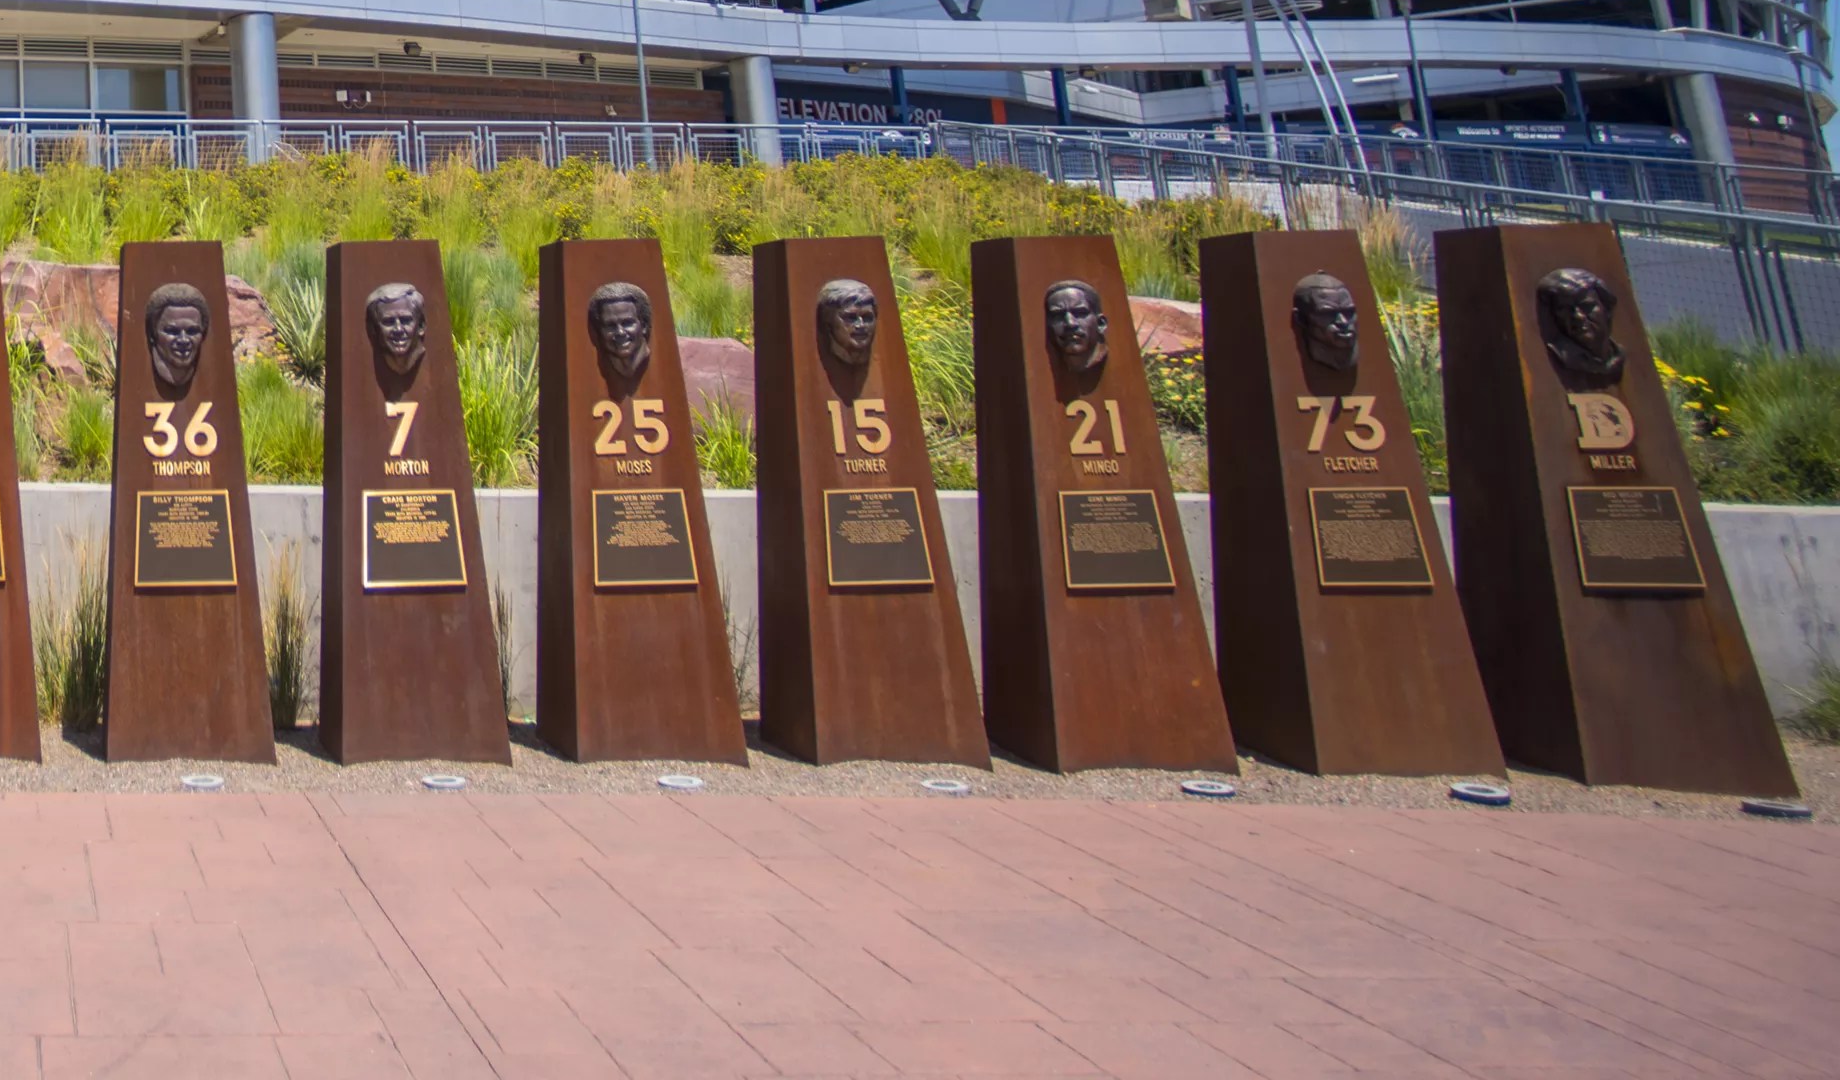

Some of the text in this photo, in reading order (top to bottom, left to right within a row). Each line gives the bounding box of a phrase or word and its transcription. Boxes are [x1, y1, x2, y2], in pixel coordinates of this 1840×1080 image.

[776, 98, 887, 123] ELEVATION
[143, 402, 218, 457] 36
[385, 402, 419, 456] 7
[593, 400, 669, 455] 25
[827, 399, 891, 454] 15
[1066, 400, 1126, 454] 21
[1297, 396, 1386, 451] 73
[1567, 393, 1634, 449] D
[152, 461, 211, 475] THOMPSON
[384, 460, 429, 475] MORTON
[617, 460, 652, 474] MOSES
[844, 459, 887, 473] TURNER
[1082, 460, 1119, 473] MINGO
[1324, 456, 1379, 471] FLETCHER
[1590, 455, 1636, 469] MILLER
